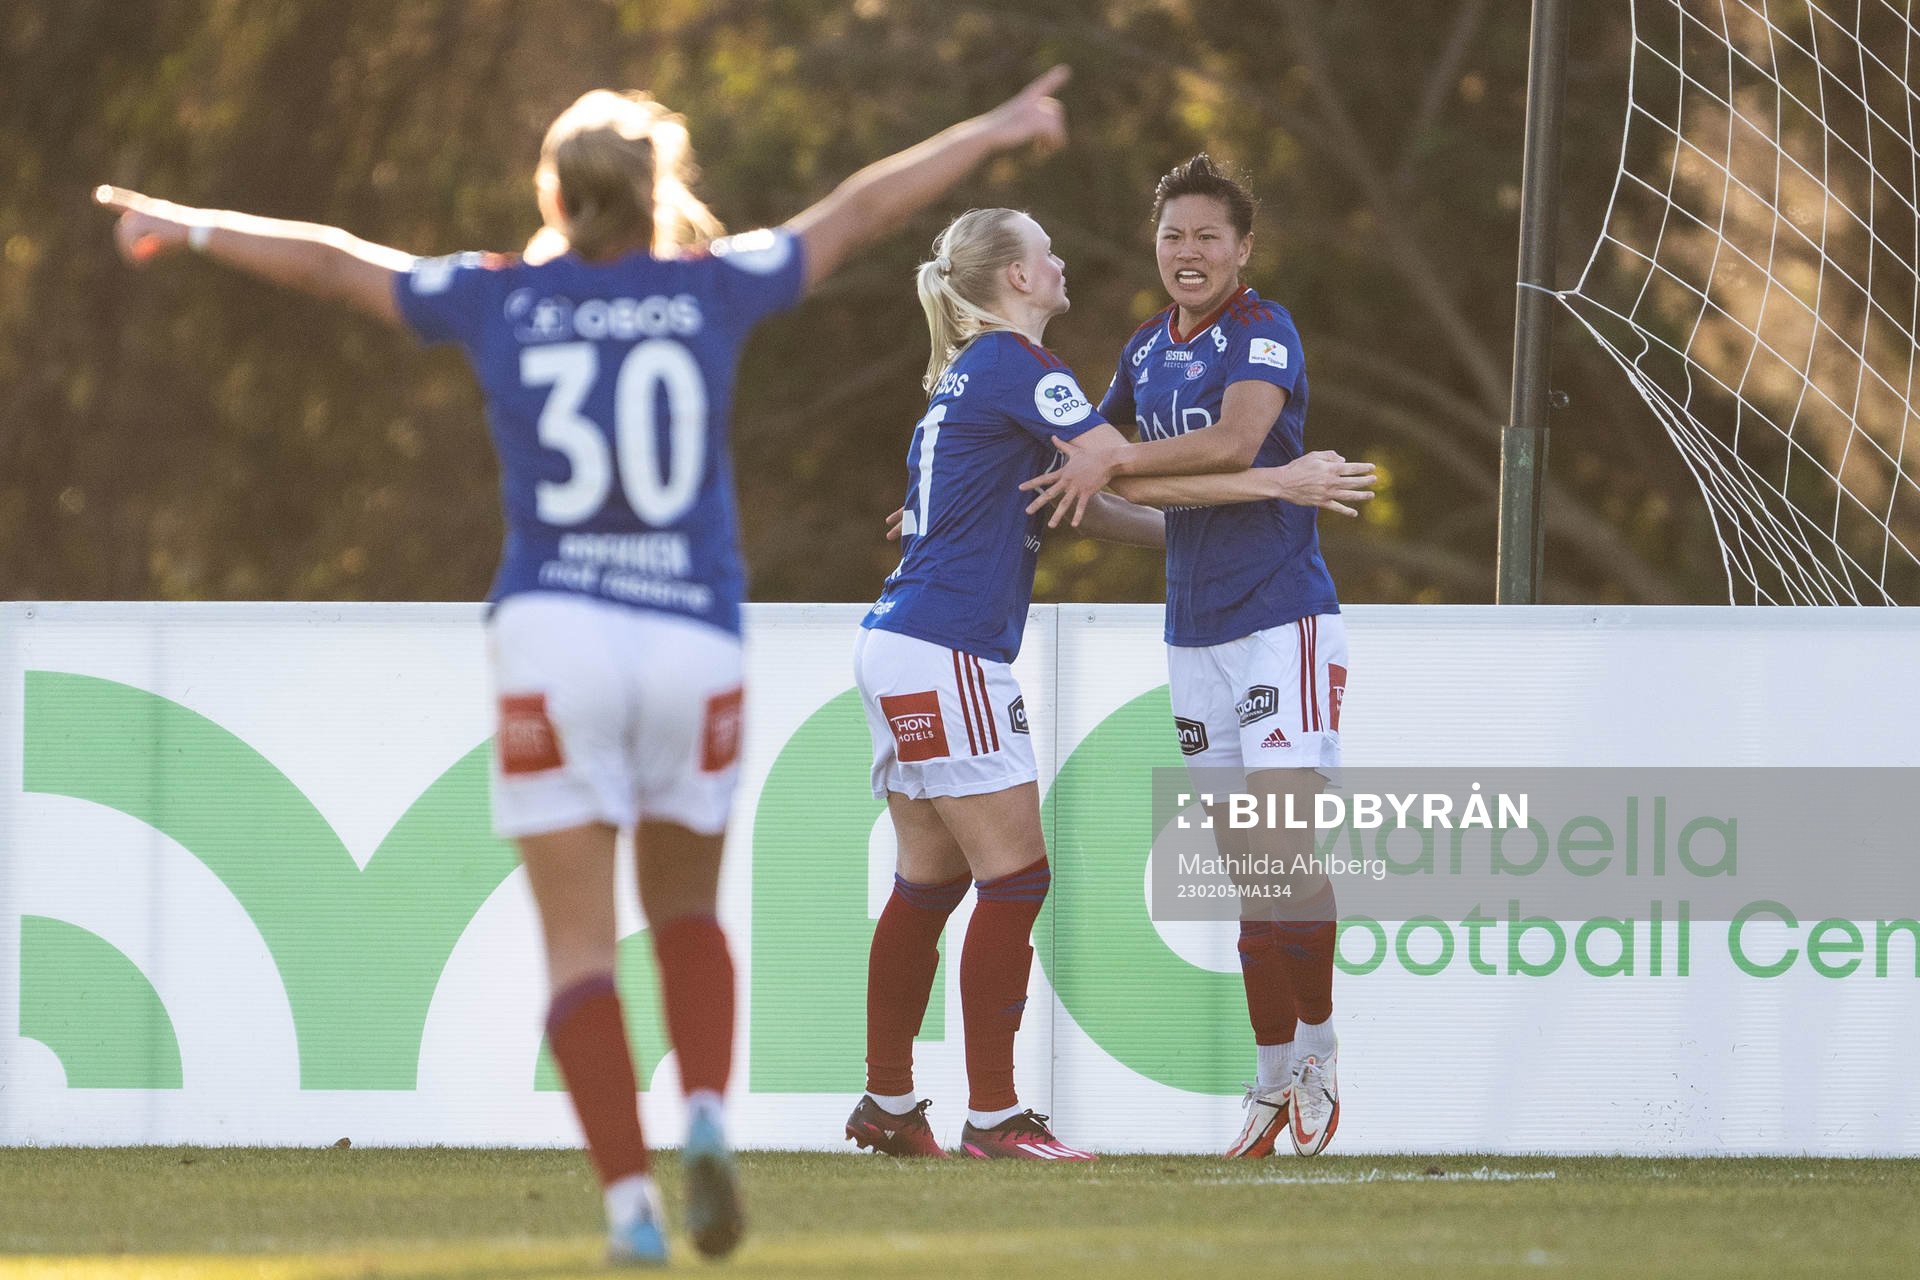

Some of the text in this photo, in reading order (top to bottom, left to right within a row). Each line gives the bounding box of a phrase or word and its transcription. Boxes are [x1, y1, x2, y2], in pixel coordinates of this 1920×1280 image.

[519, 338, 711, 527] 30
[902, 404, 947, 537] 1
[1176, 727, 1199, 743] oni
[1260, 740, 1291, 748] adidas
[1334, 900, 1690, 977] ootball
